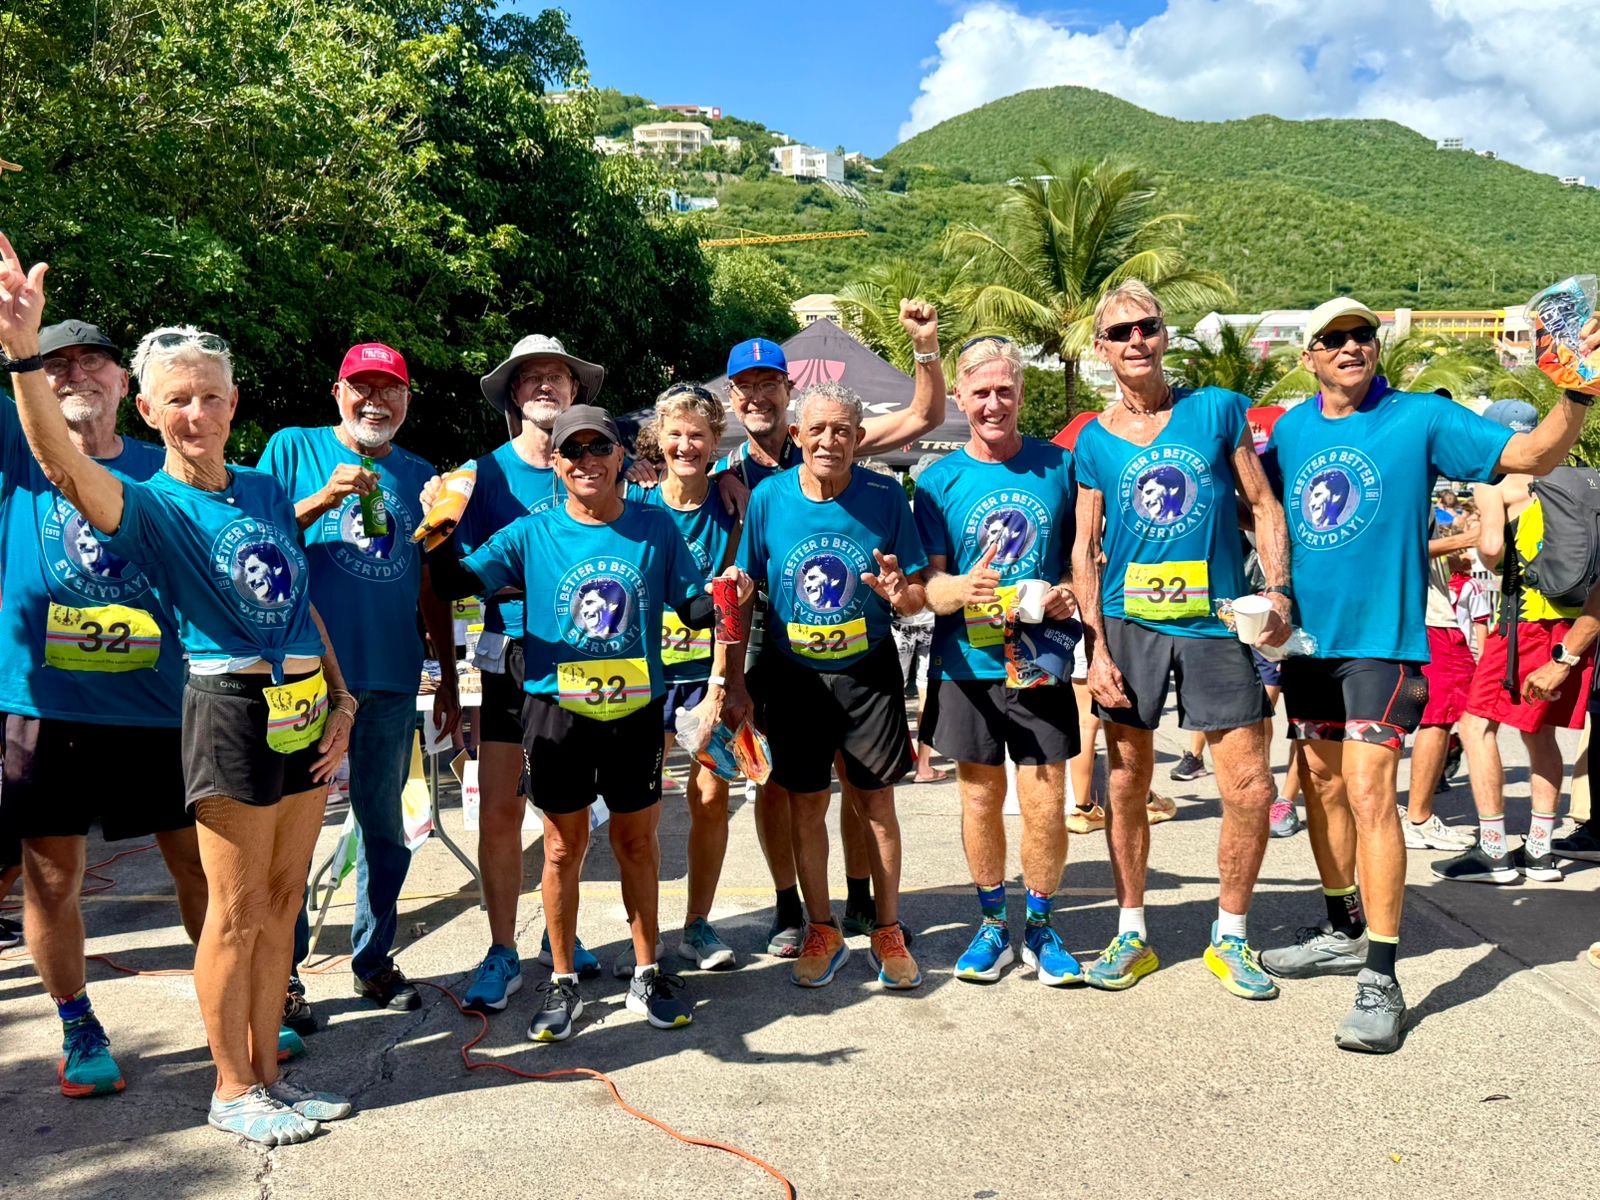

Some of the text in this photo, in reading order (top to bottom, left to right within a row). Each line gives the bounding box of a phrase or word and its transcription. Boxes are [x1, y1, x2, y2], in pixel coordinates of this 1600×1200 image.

[1121, 448, 1206, 498] BETTER & BETTER
[1293, 451, 1376, 495] BETTER & BETTER
[382, 490, 413, 532] BETTER
[966, 492, 1048, 534] BETTER & BETTER
[1134, 502, 1207, 538] EVERYDAY!
[45, 527, 60, 537] ESTD
[1297, 515, 1365, 545] EVERYDAY!
[215, 526, 245, 574] BETTER
[244, 522, 255, 533] &
[784, 537, 868, 577] BETTER & BETTER
[559, 560, 646, 602] BETTER & BETTER
[1147, 576, 1187, 604] 32
[78, 621, 131, 654] 32
[809, 629, 848, 654] 32
[219, 681, 246, 690] ONLY
[584, 675, 627, 706] 32
[466, 786, 480, 794] HU
